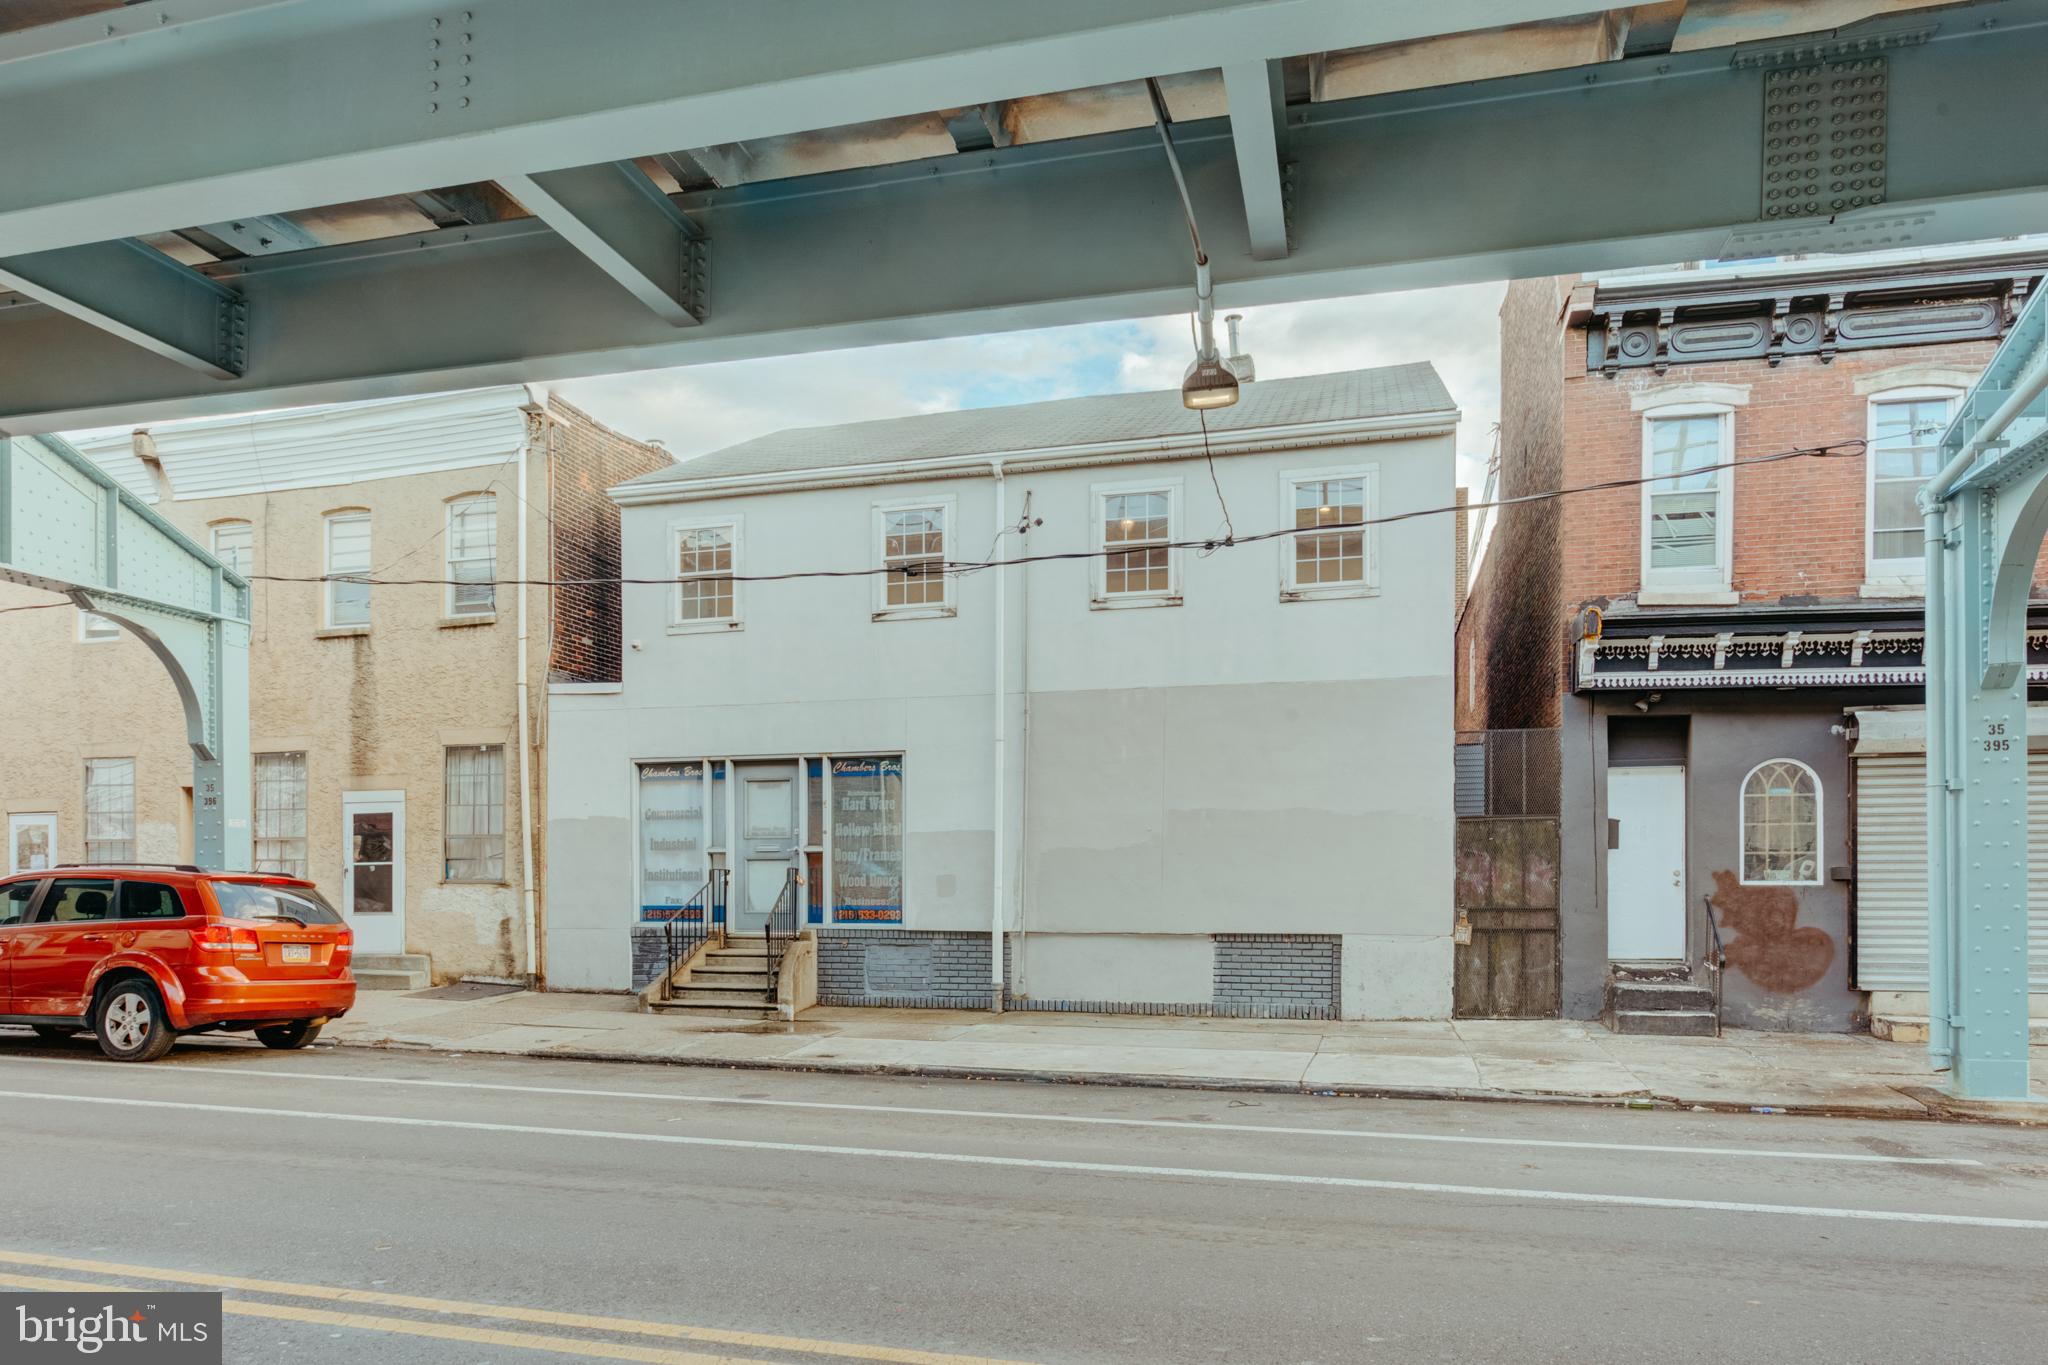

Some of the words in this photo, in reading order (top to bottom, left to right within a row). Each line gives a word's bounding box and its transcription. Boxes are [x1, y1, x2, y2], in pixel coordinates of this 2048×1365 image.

[1988, 724, 2005, 735] 35
[1983, 739, 2010, 751] 395
[641, 766, 680, 779] Chambers
[832, 761, 876, 774] Chambers
[842, 797, 867, 811] Hard
[644, 805, 703, 820] Commercial
[835, 822, 871, 836] Hollow
[650, 837, 697, 850] Industrial
[643, 868, 703, 881] Institutional
[839, 873, 867, 888] Wood
